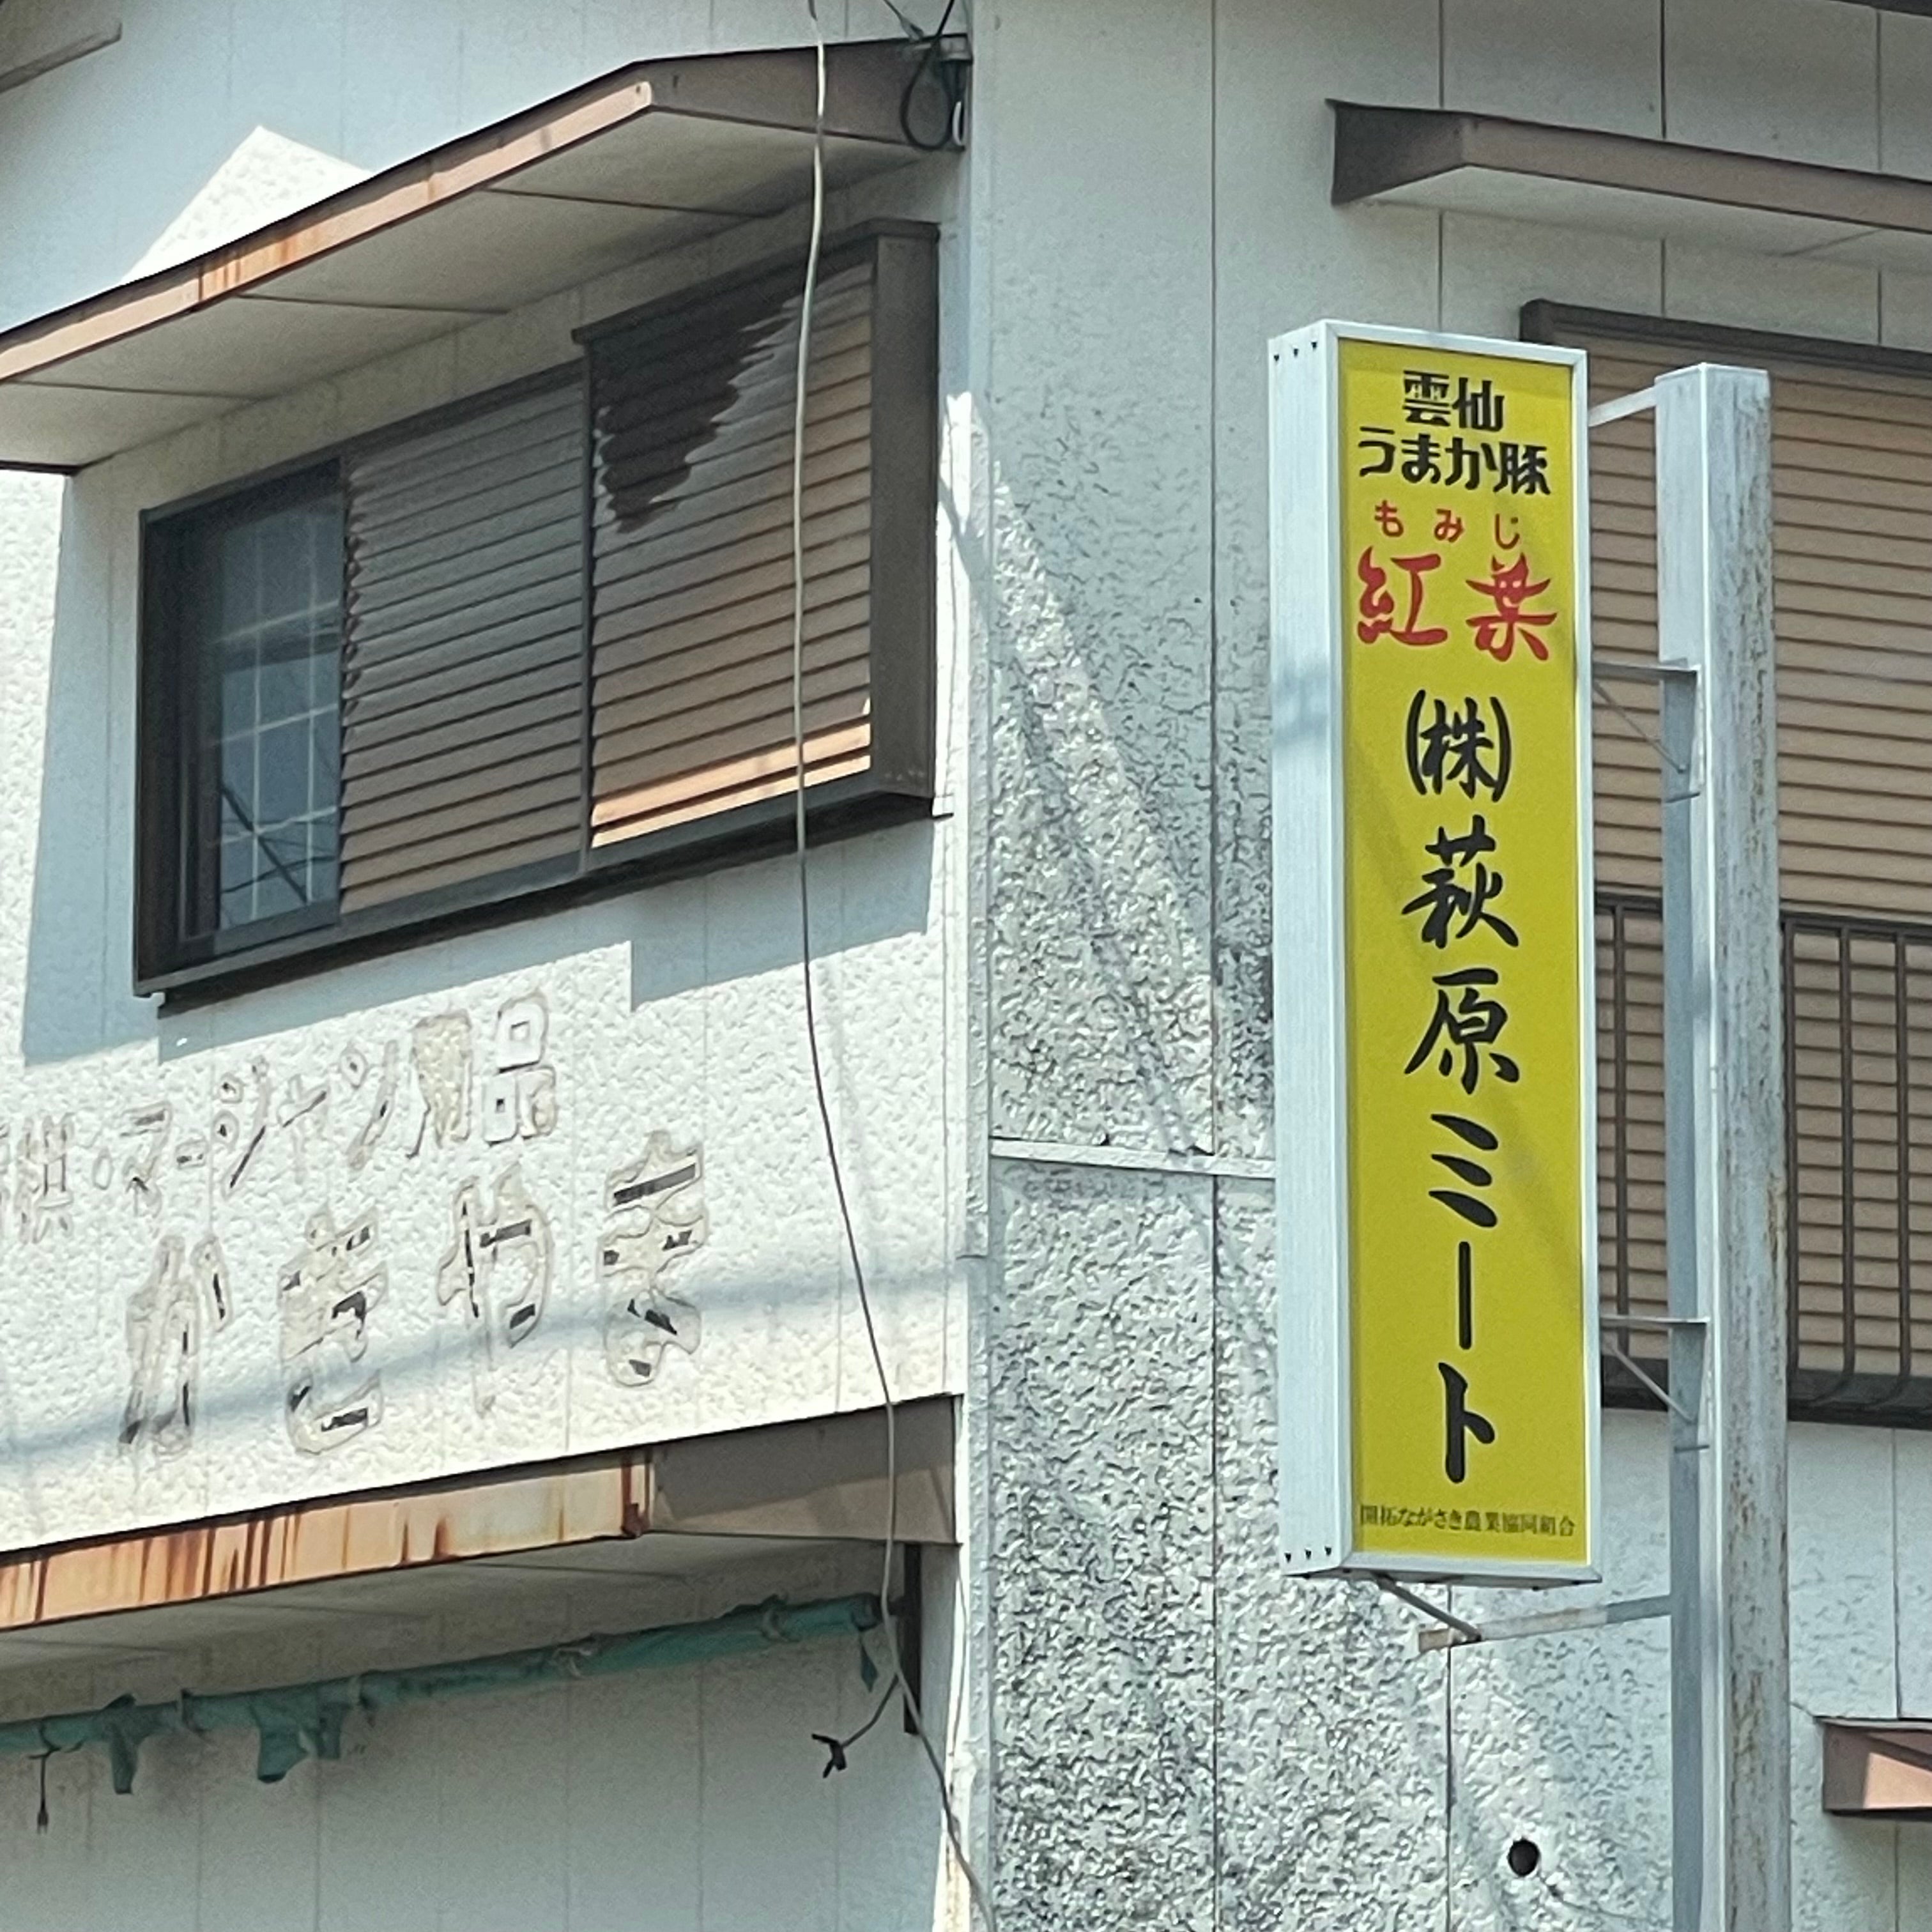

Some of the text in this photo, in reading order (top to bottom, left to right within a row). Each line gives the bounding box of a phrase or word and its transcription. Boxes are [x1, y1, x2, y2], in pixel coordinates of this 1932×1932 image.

[1402, 370, 1505, 433] 雲仙
[1358, 426, 1551, 496] うまか豚
[1374, 500, 1521, 550] もみじ
[1357, 546, 1558, 662] 紅葉
[1360, 1503, 1576, 1537] 開拓ながさき農業協同組合
